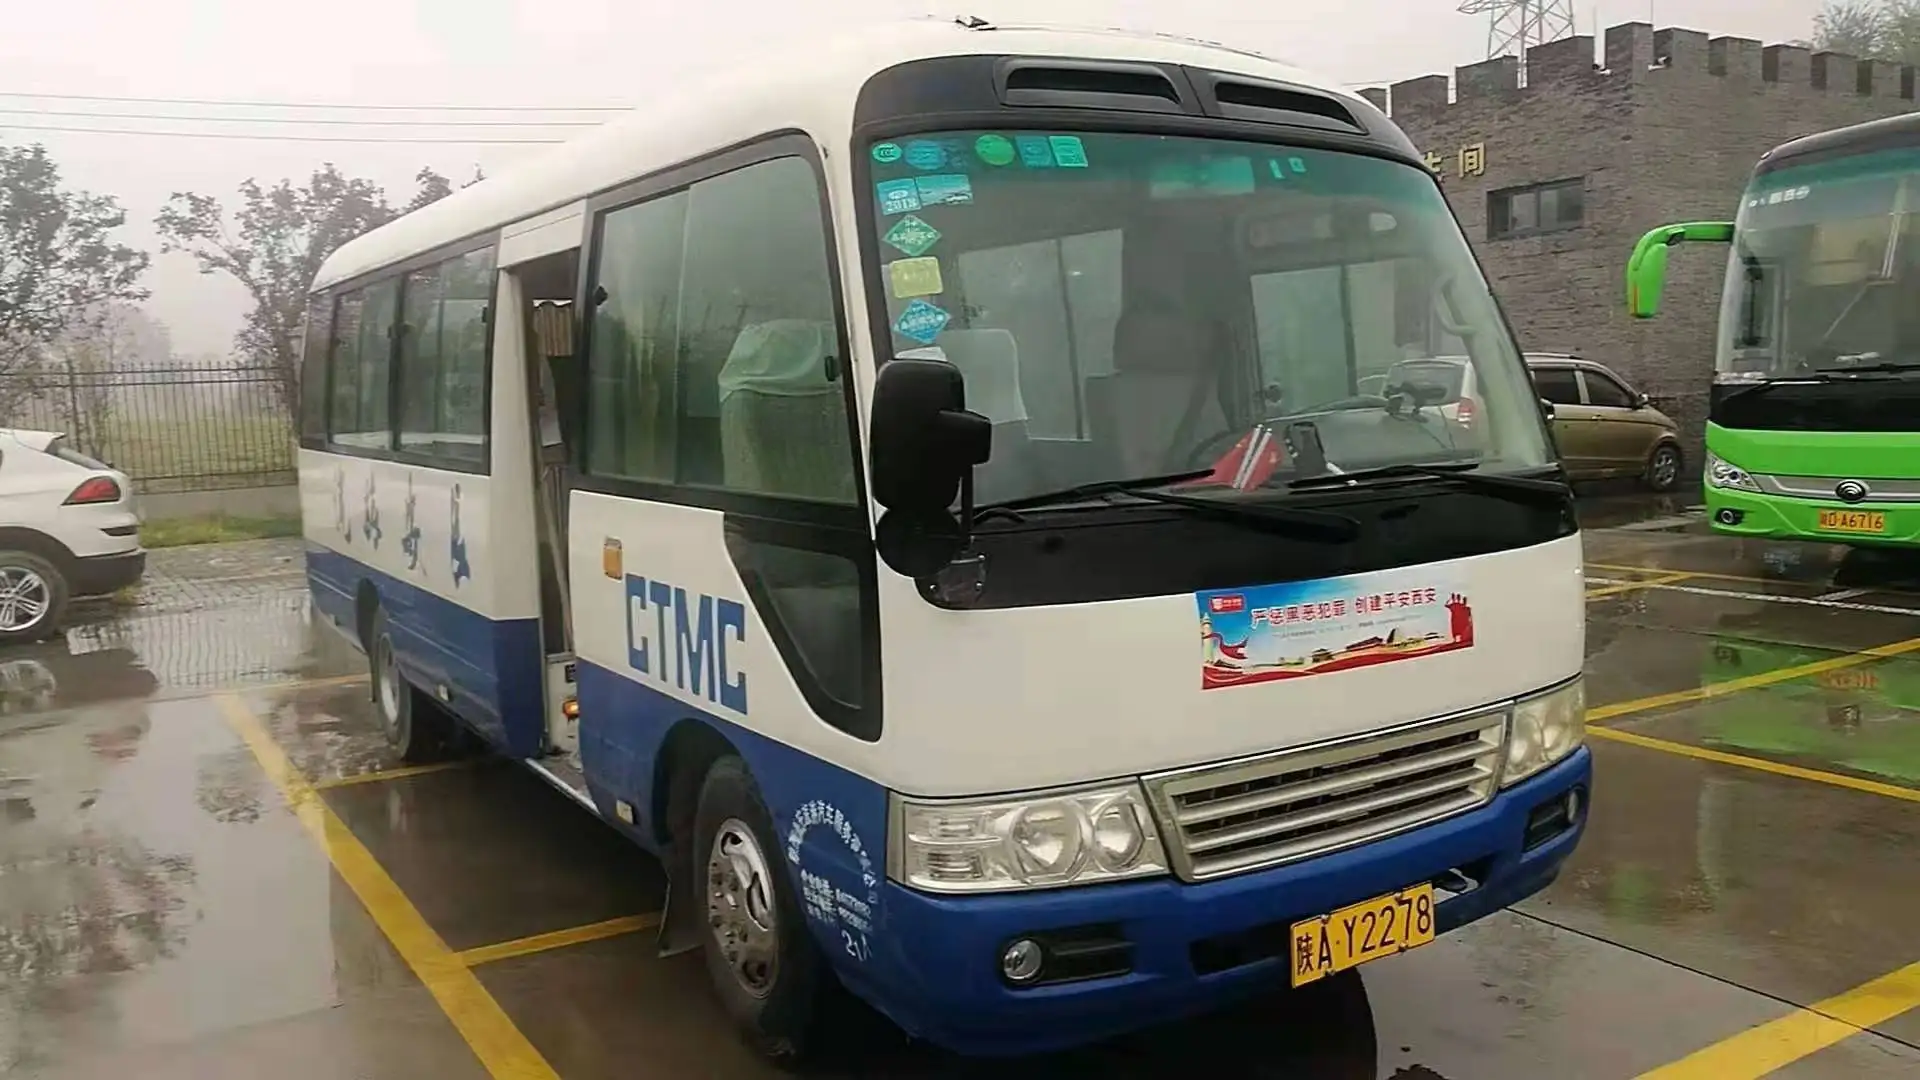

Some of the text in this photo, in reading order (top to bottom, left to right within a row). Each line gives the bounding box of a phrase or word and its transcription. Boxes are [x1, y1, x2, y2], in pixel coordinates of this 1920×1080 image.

[885, 197, 918, 212] 2018
[1251, 598, 1347, 632] 严惩黑恶犯罪
[1355, 588, 1437, 614] 创建平安西安
[625, 573, 748, 715] CTMC
[1296, 893, 1431, 976] 陕A·Y2278
